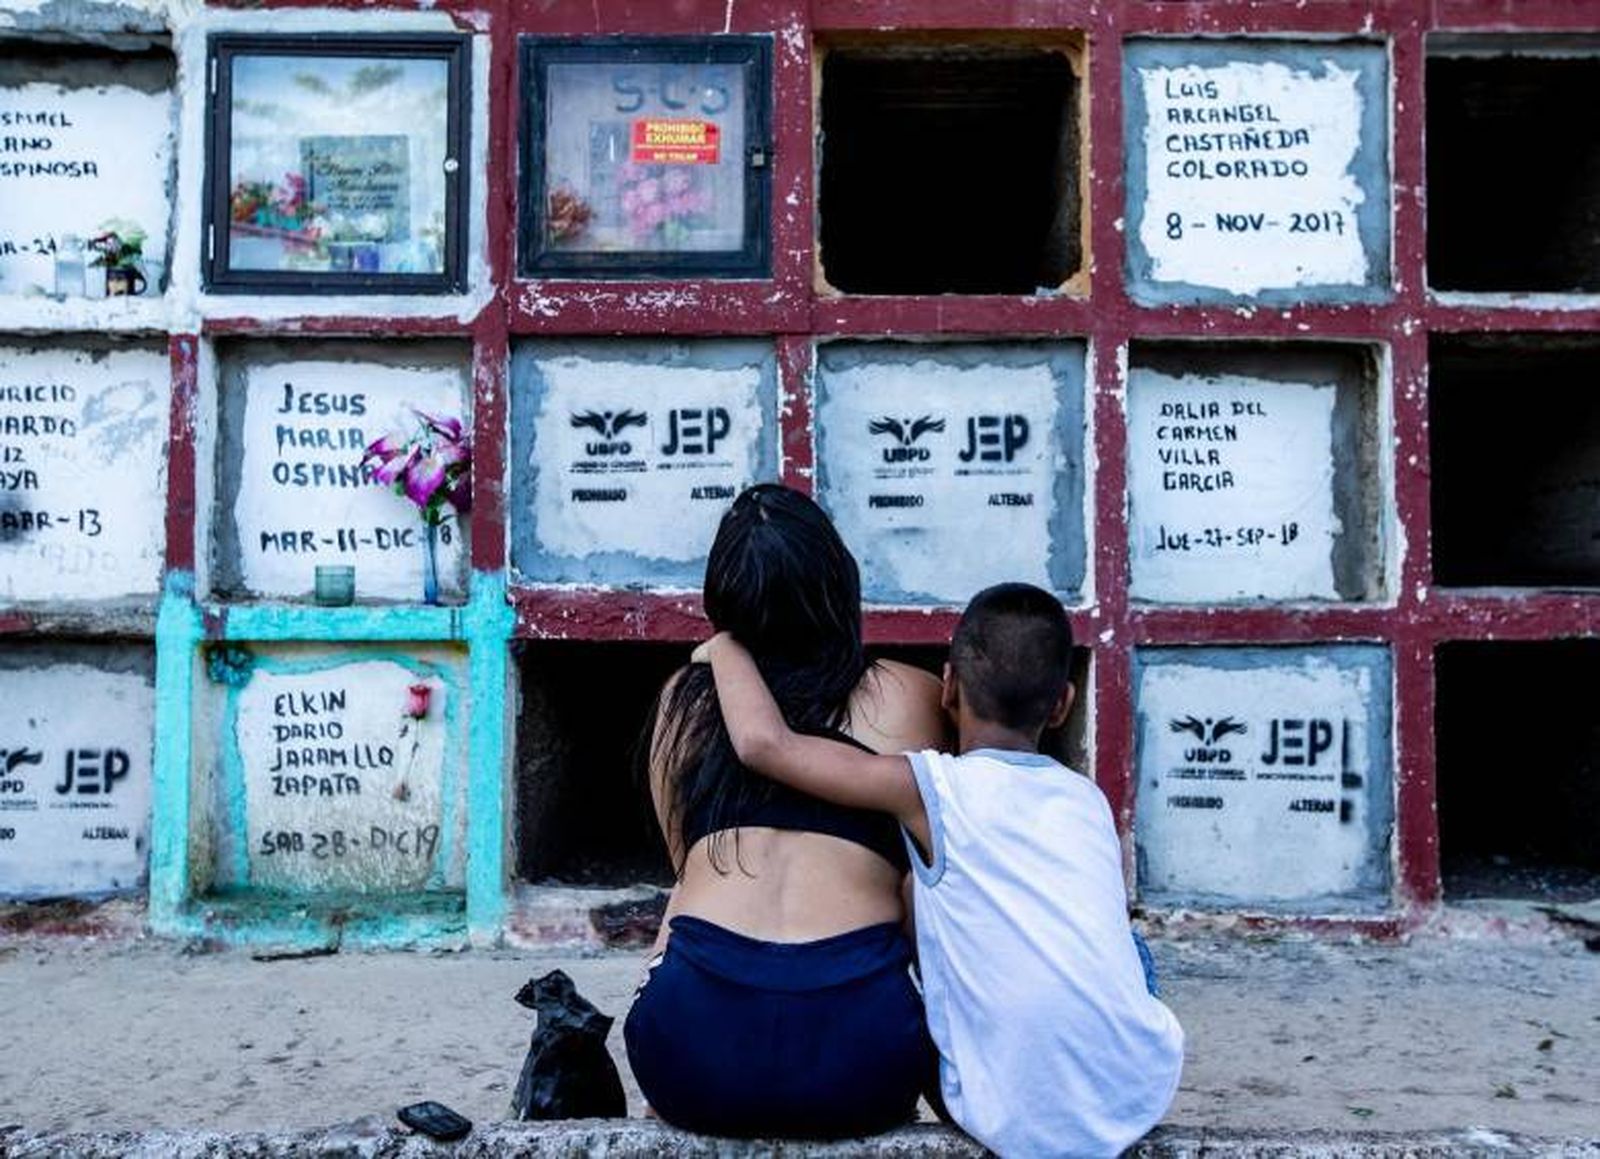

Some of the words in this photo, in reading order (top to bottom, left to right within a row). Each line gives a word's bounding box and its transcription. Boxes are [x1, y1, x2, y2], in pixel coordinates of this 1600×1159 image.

[1165, 79, 1218, 99] LUIS
[1167, 104, 1280, 124] ARCANGEL
[1166, 128, 1310, 153] CASTAÑEDA
[1166, 160, 1309, 180] COLORADO
[1166, 211, 1183, 240] 8
[1288, 211, 1345, 235] 2017
[278, 383, 367, 416] JESUS
[1160, 402, 1219, 422] DALIA
[1231, 400, 1267, 417] DEL
[0, 415, 77, 437] ARDO
[660, 407, 731, 456] JEP
[958, 413, 1029, 463] JEP
[1156, 424, 1238, 442] CARMEN
[275, 424, 365, 456] MARIA
[1158, 449, 1221, 465] VILLA
[1163, 470, 1235, 492] GARCIA
[274, 689, 346, 717] ELKIN
[272, 721, 343, 743] DARIO
[1261, 718, 1333, 766] JEP
[55, 748, 130, 795] JEP
[271, 773, 361, 797] ZAPATA
